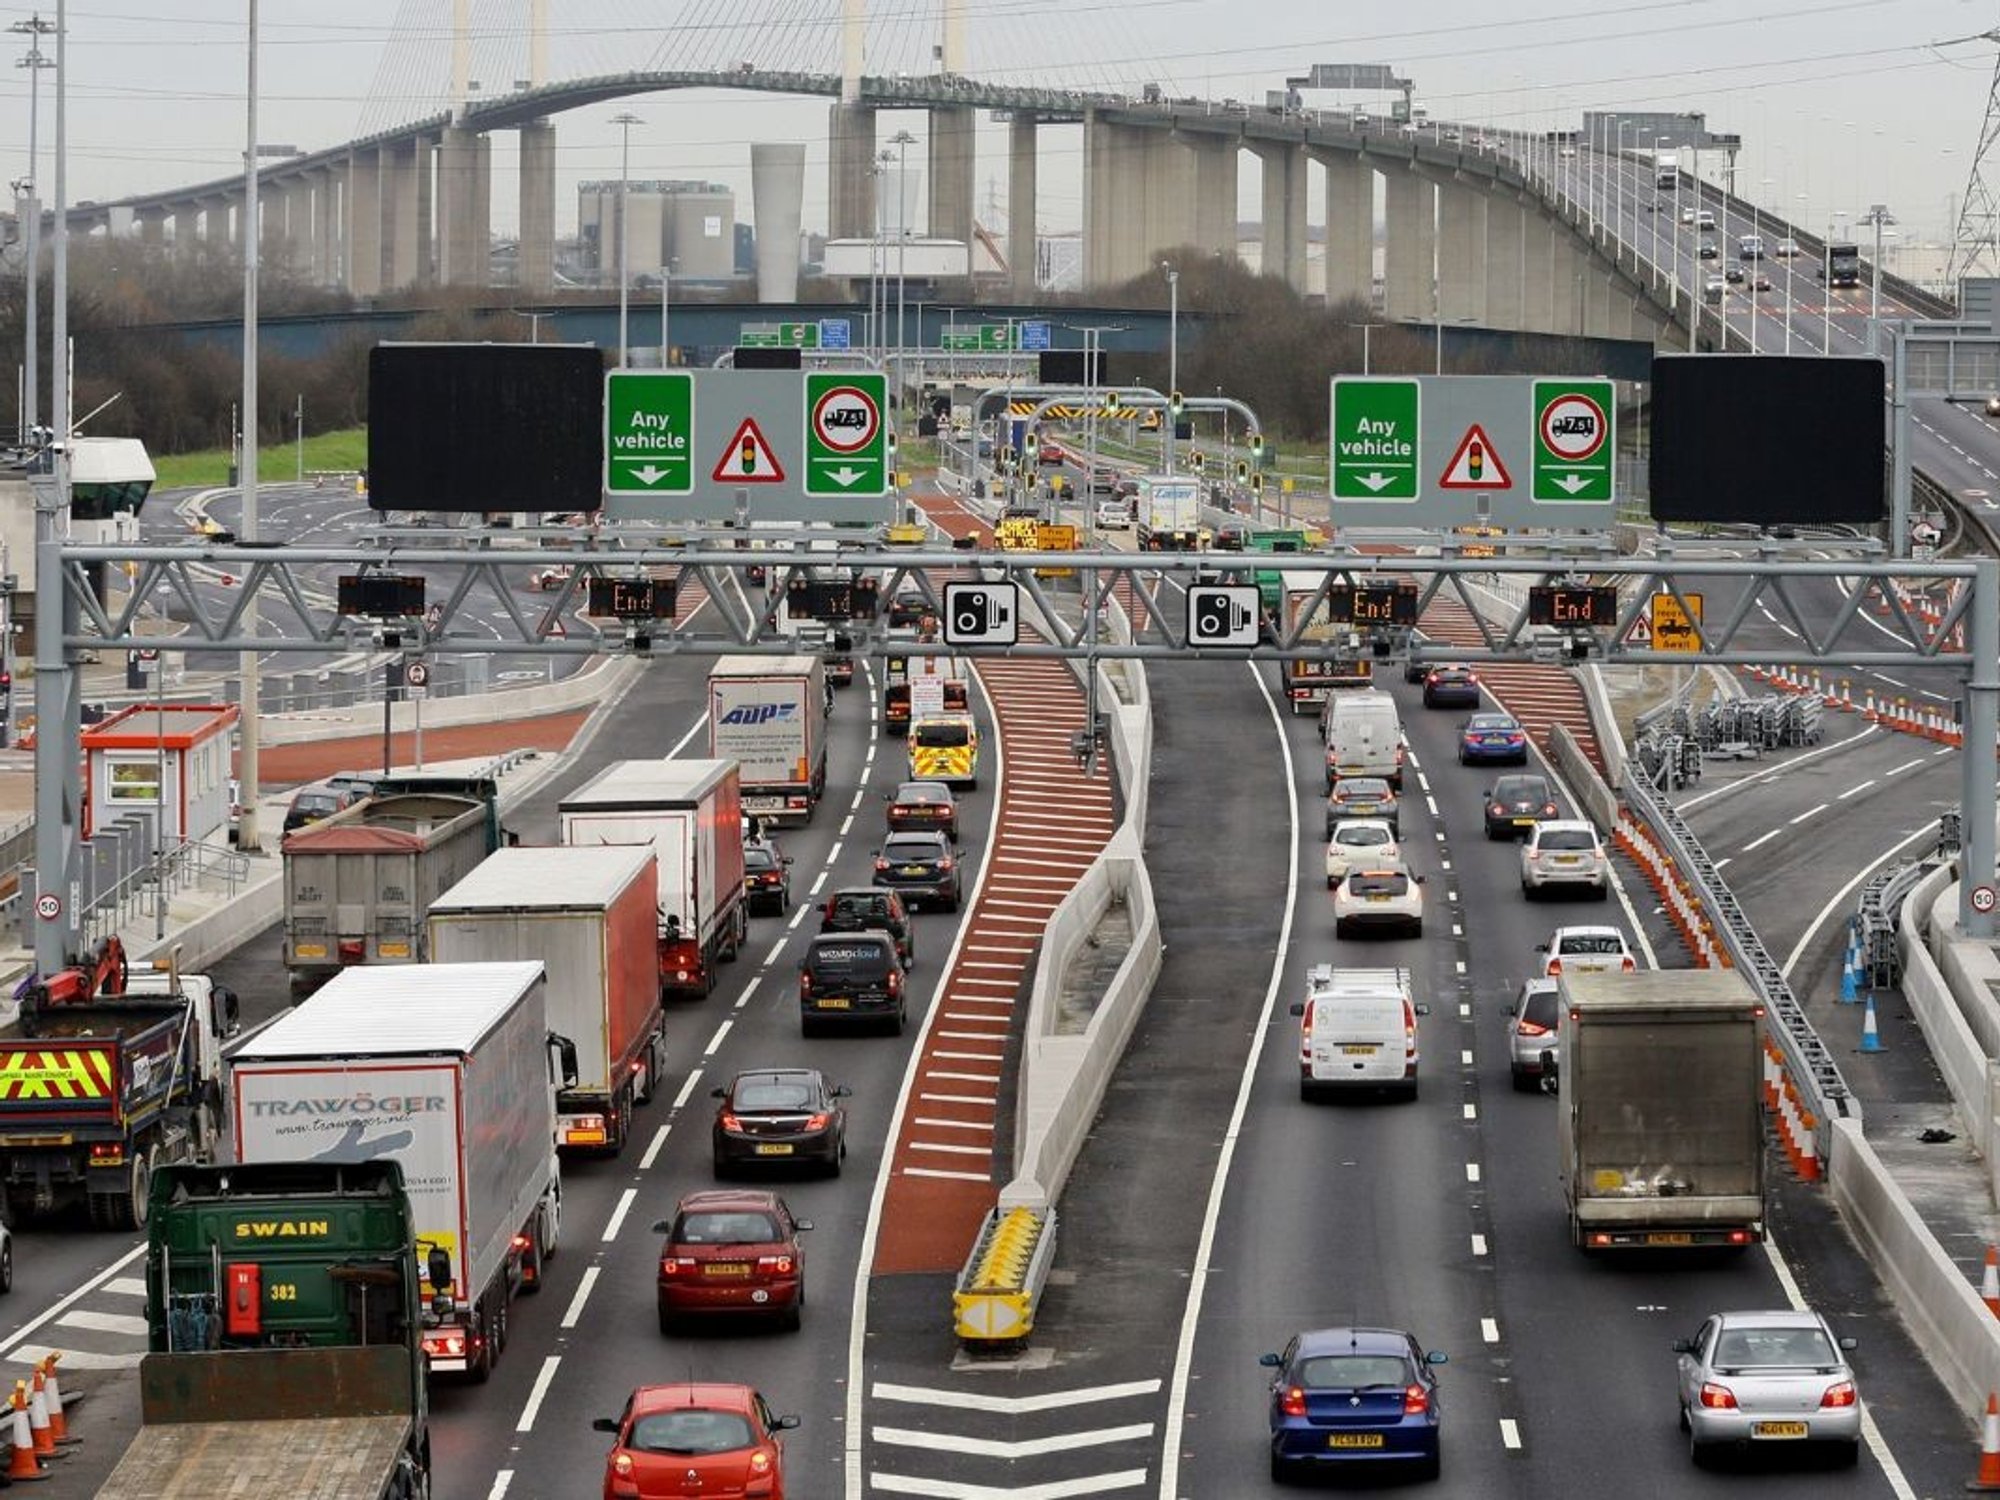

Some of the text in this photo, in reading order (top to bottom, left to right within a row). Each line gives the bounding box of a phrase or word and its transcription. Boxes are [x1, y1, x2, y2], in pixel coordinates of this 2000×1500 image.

[631, 410, 670, 431] Any
[1357, 416, 1396, 437] Any
[614, 431, 686, 449] vehicle
[1340, 438, 1412, 455] vehicle
[614, 584, 651, 612] End
[1354, 590, 1393, 618] End
[1553, 592, 1592, 620] End
[41, 901, 58, 912] 50
[1975, 894, 1992, 905] 50
[247, 1092, 447, 1116] TRAWÖGER
[235, 1221, 329, 1238] SWAIN
[270, 1283, 297, 1301] 382
